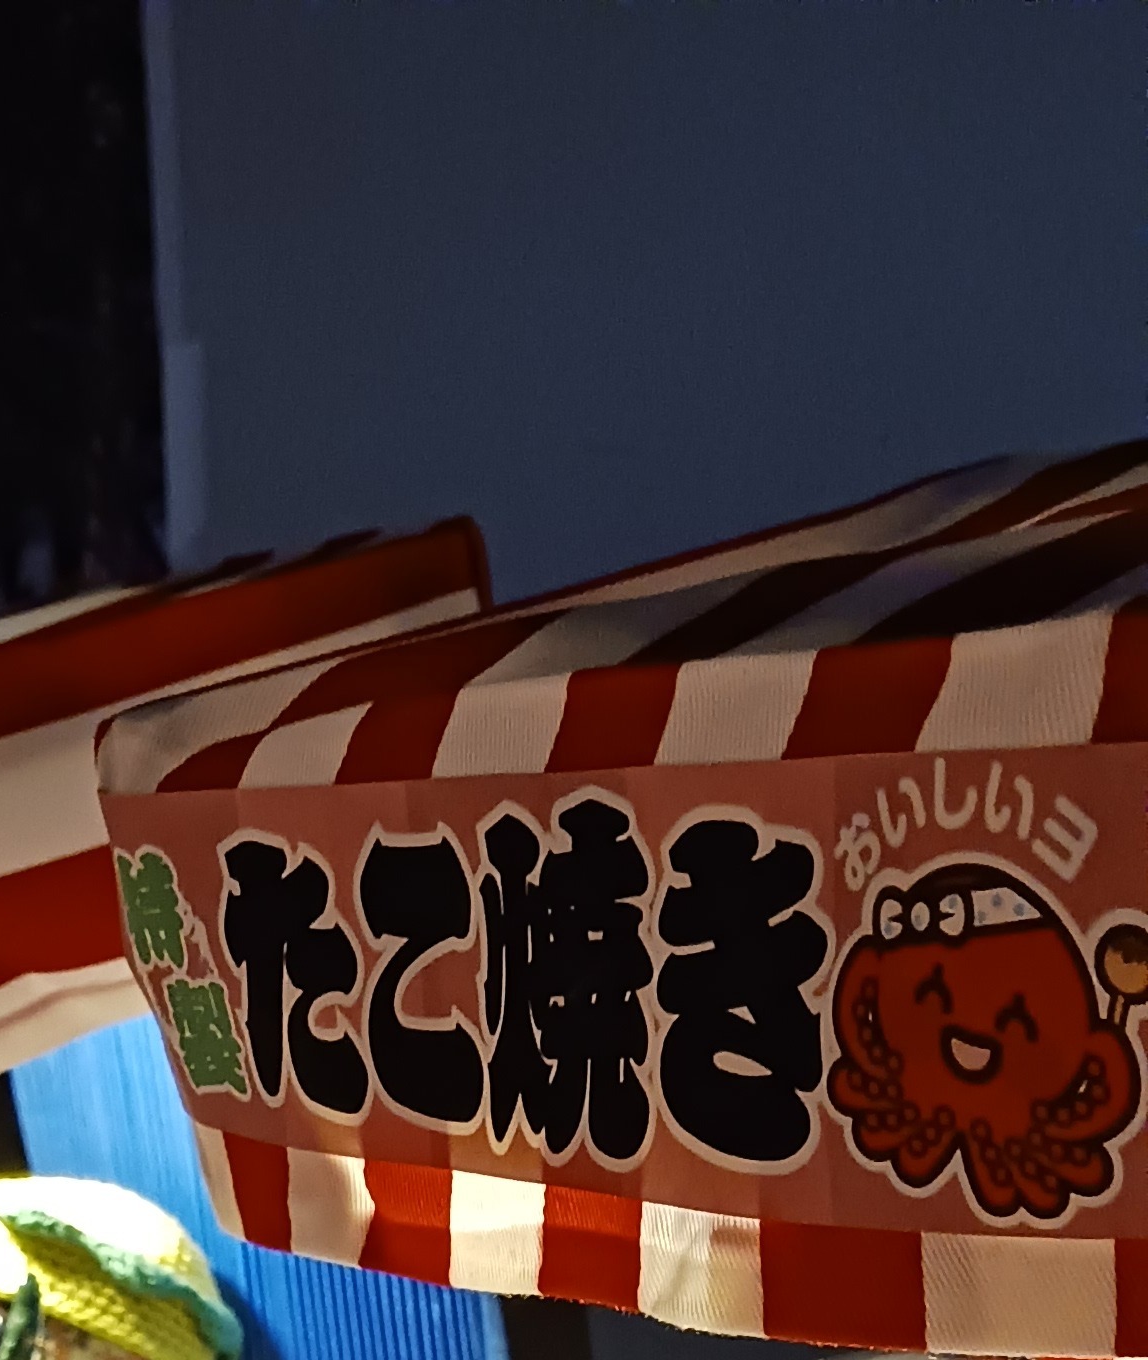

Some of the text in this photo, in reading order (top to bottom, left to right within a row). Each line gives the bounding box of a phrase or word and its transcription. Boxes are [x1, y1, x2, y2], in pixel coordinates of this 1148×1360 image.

[834, 757, 1099, 891] おいしいヨ
[116, 849, 248, 1094] 特製
[222, 798, 829, 1164] たこ焼き
